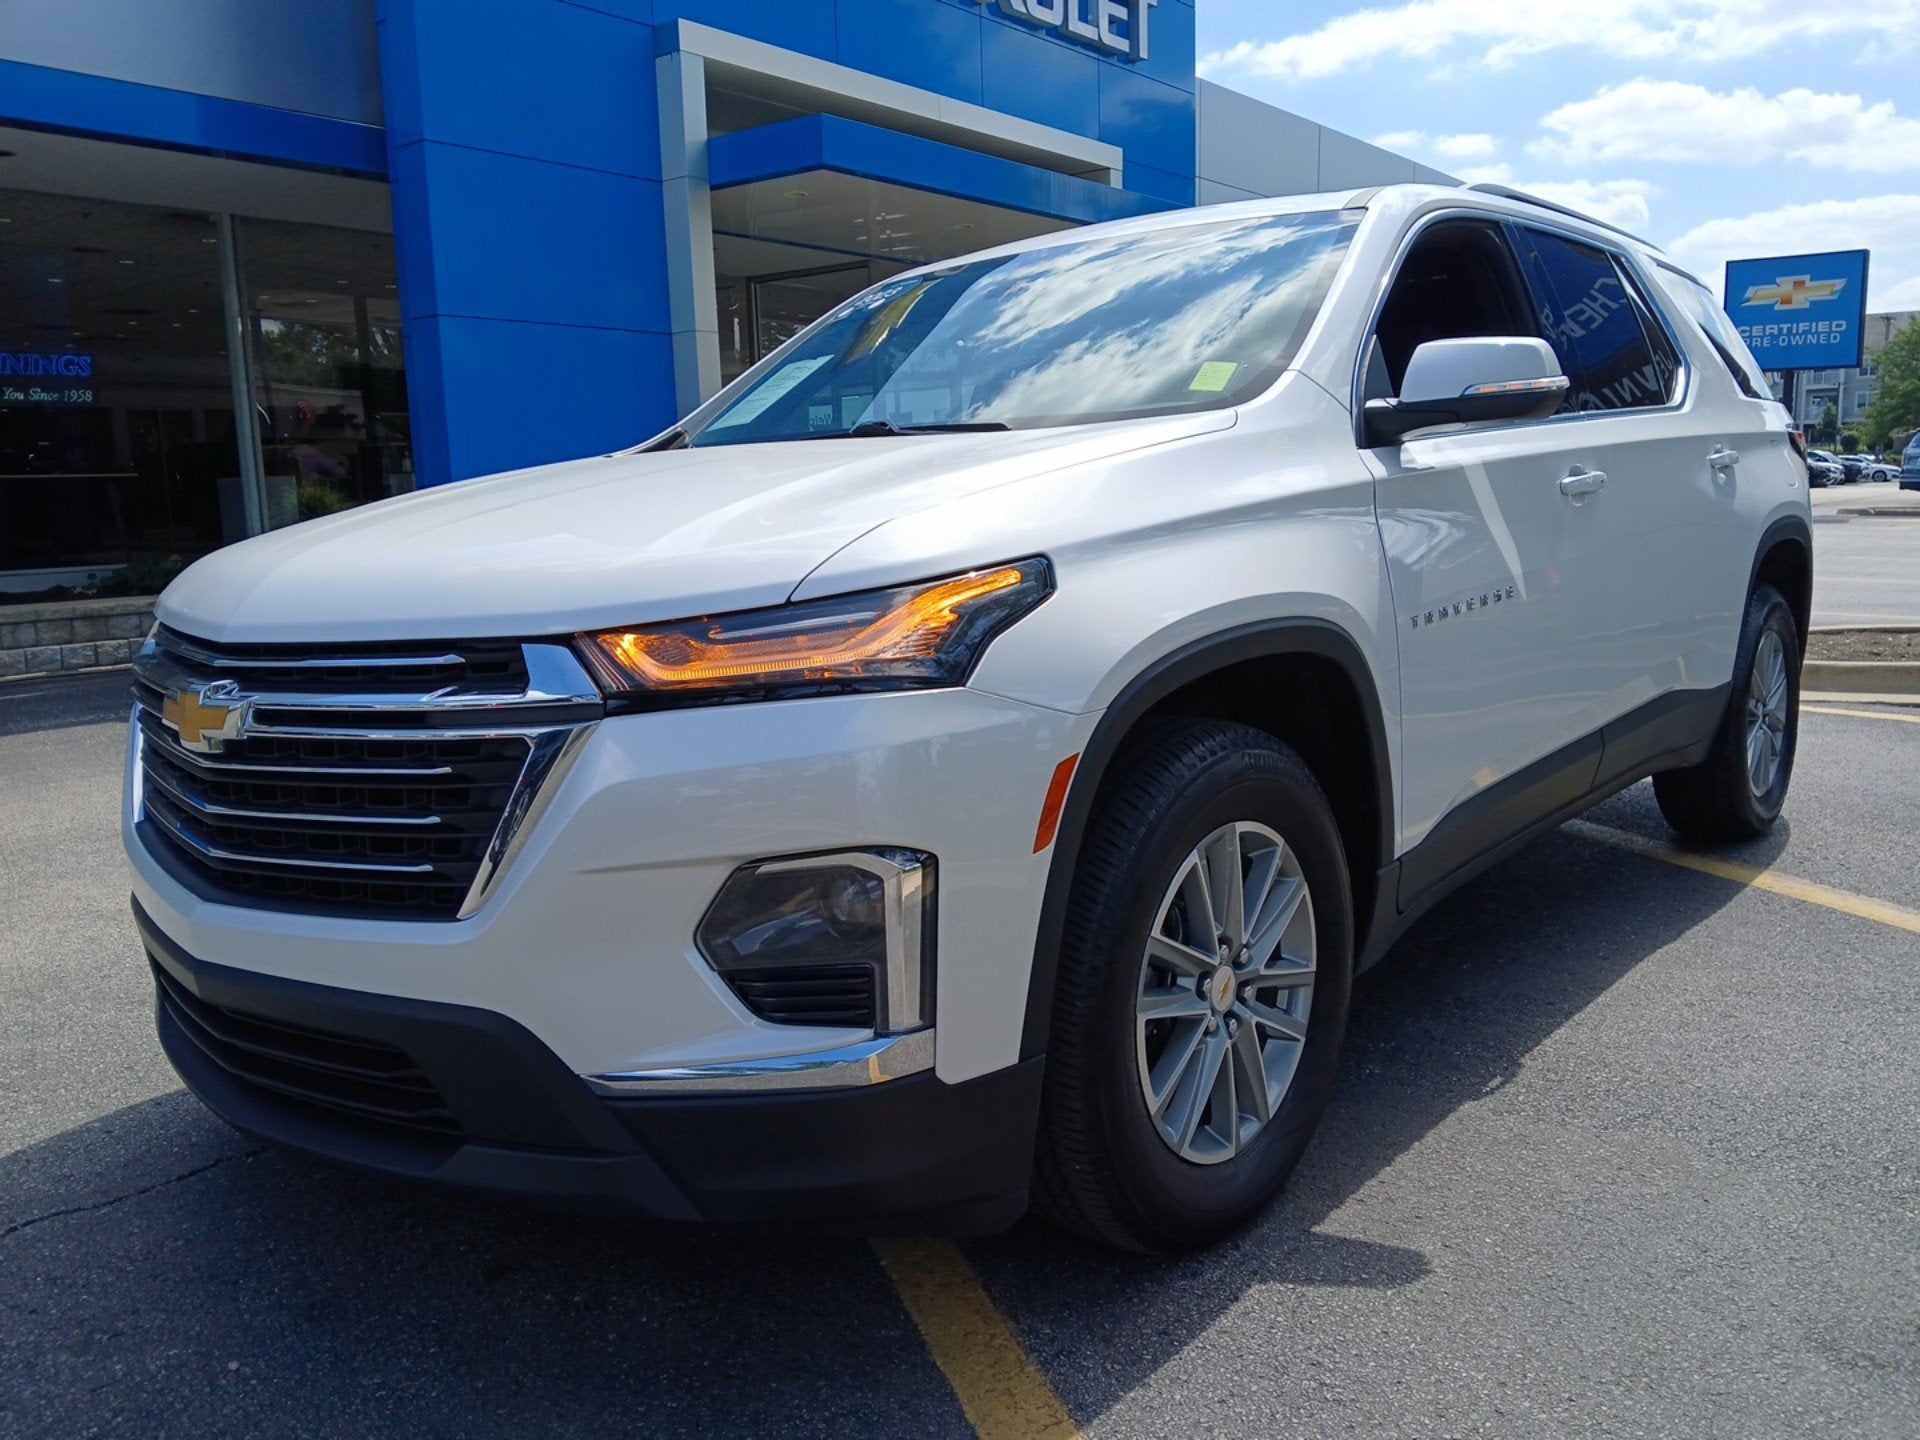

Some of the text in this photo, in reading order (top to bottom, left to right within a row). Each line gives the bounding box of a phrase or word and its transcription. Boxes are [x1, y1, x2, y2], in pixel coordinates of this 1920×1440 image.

[1737, 320, 1847, 337] CERTIFIED
[3, 387, 93, 402] You Since 1958
[1409, 585, 1514, 630] TRAVERSE
